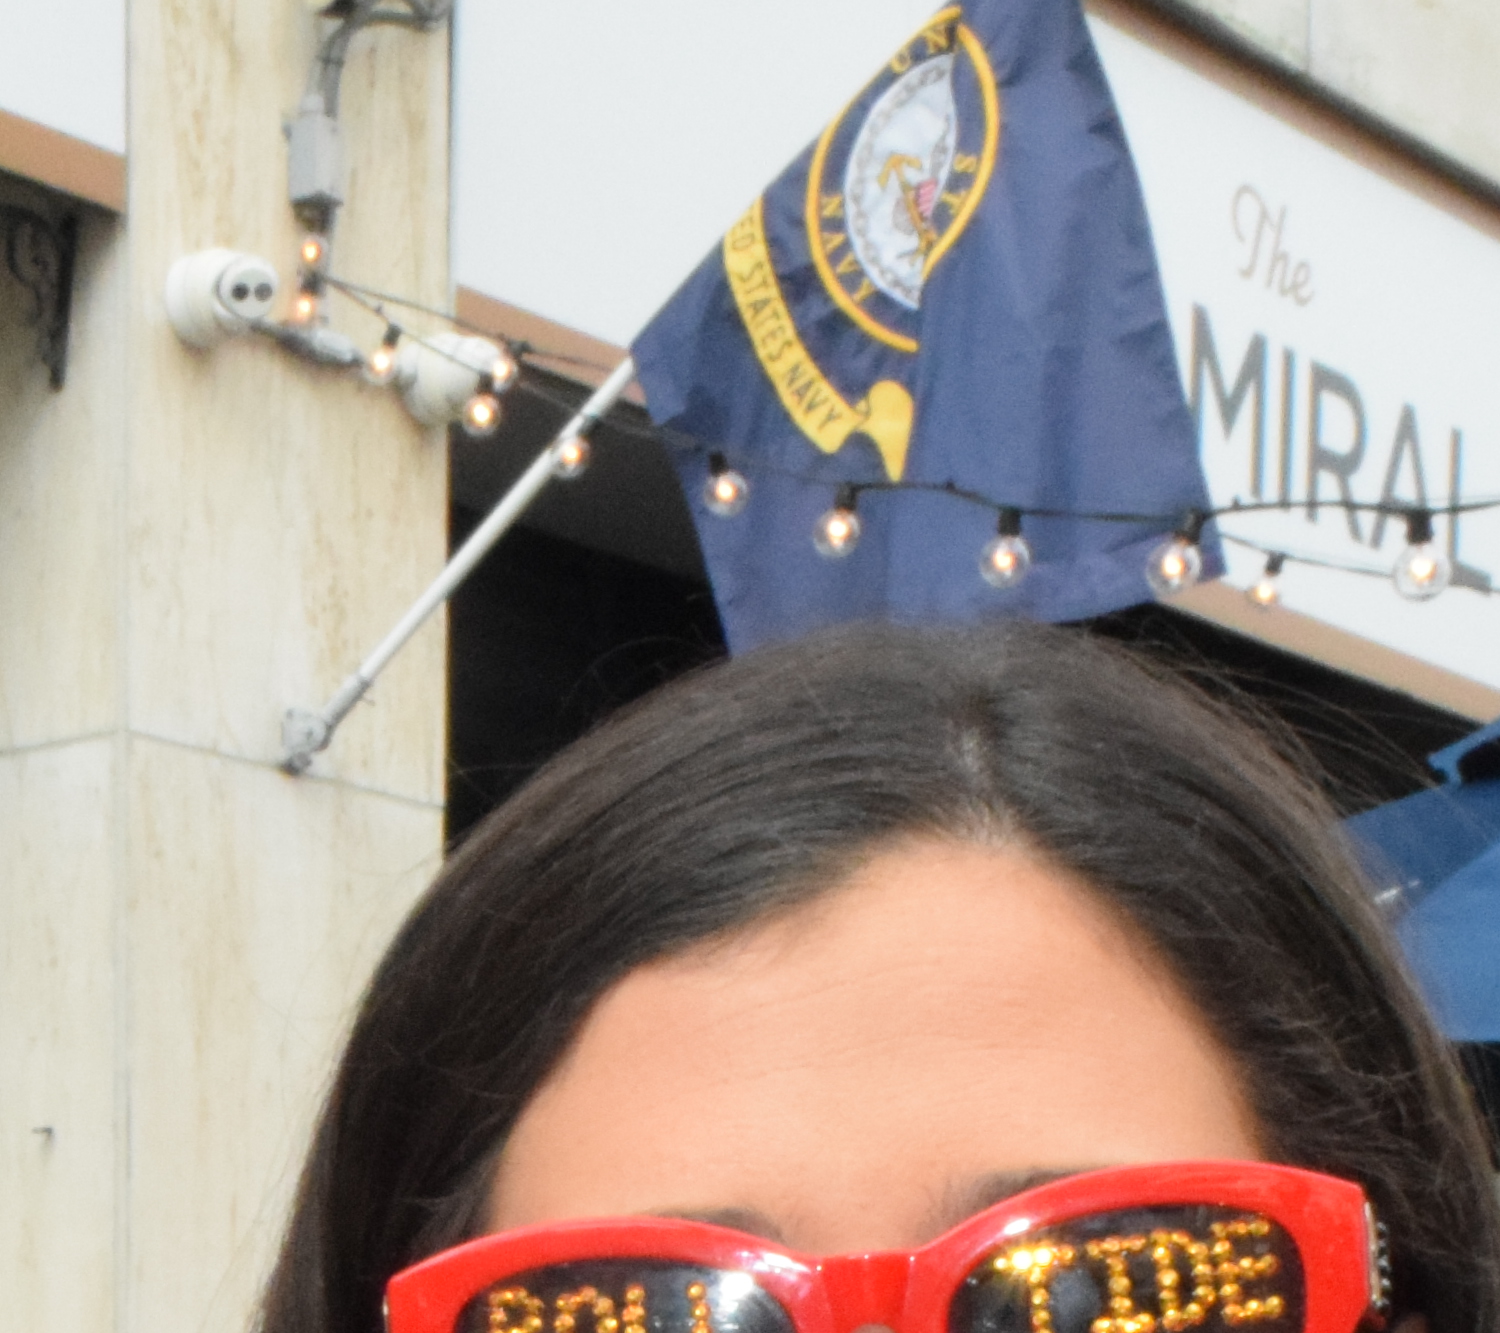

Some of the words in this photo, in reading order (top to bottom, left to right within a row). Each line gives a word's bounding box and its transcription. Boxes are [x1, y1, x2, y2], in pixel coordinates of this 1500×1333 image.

[1231, 184, 1315, 307] The
[737, 260, 795, 364] STATES
[782, 362, 843, 434] NAVY
